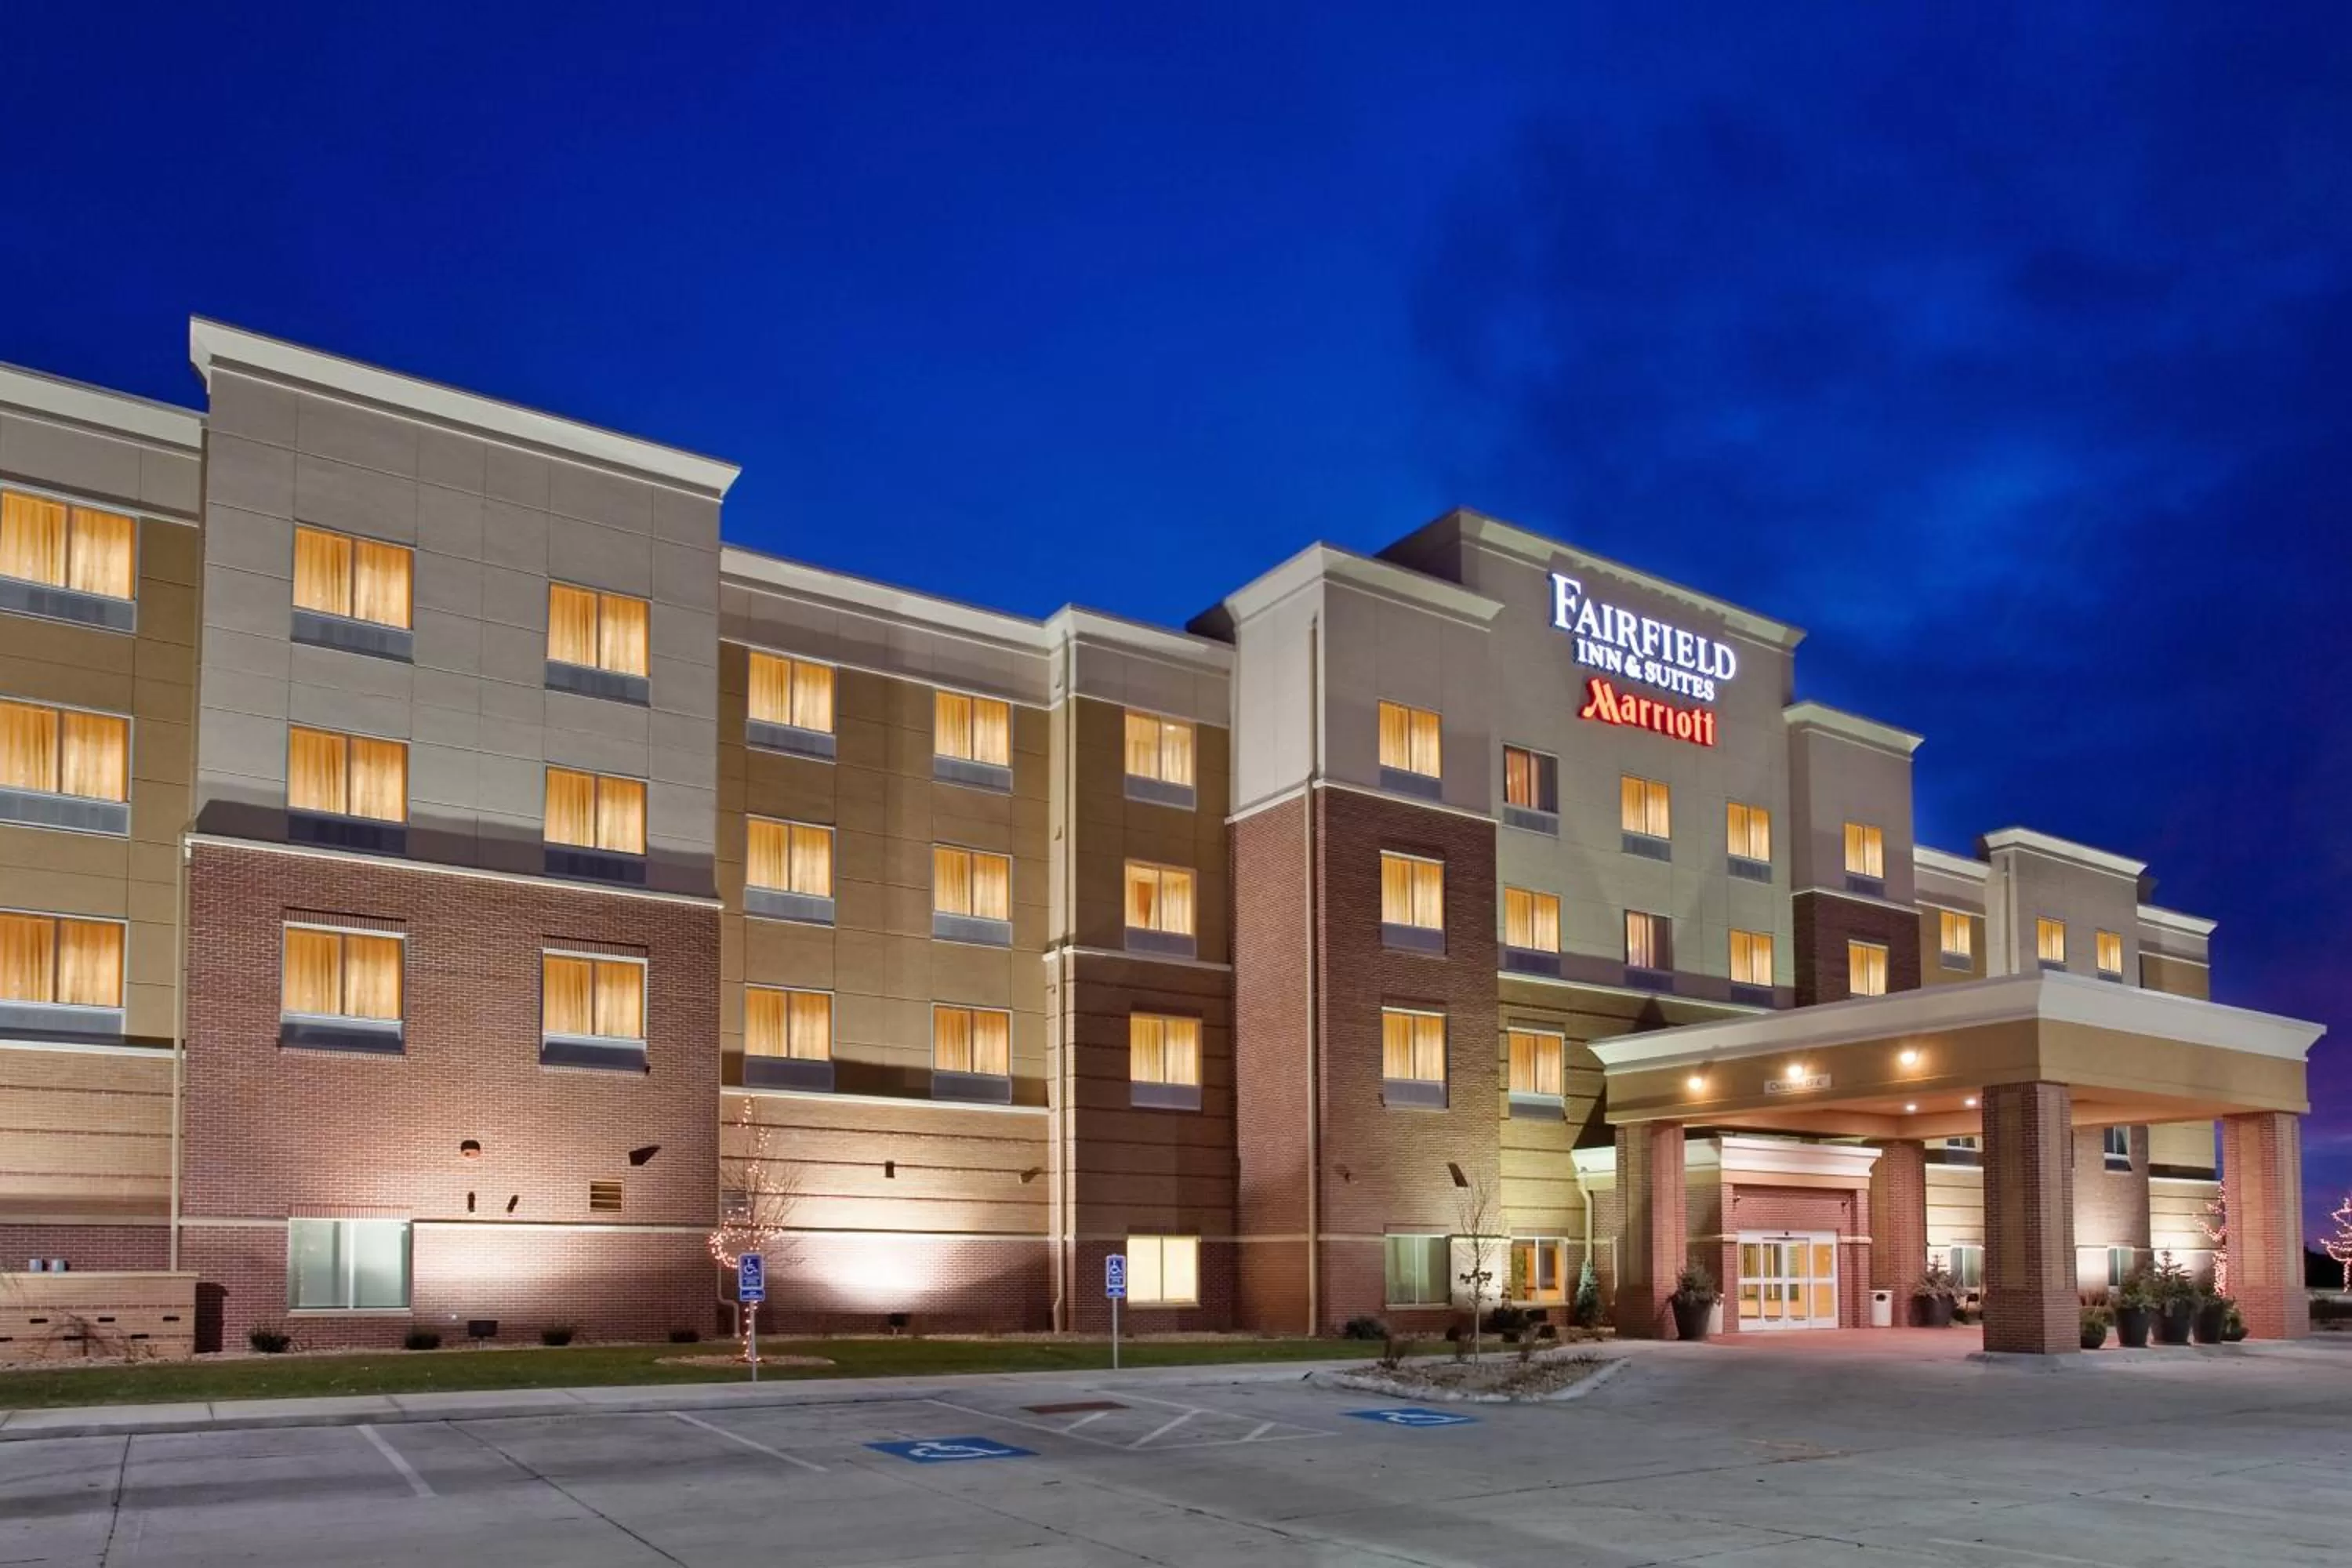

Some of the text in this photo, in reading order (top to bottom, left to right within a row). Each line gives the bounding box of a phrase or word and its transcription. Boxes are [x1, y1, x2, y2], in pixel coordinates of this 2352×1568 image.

[1552, 573, 1737, 681] FAIRFIELD
[1576, 638, 1715, 702] INN & SUITES
[1581, 677, 1715, 746] Marriott
